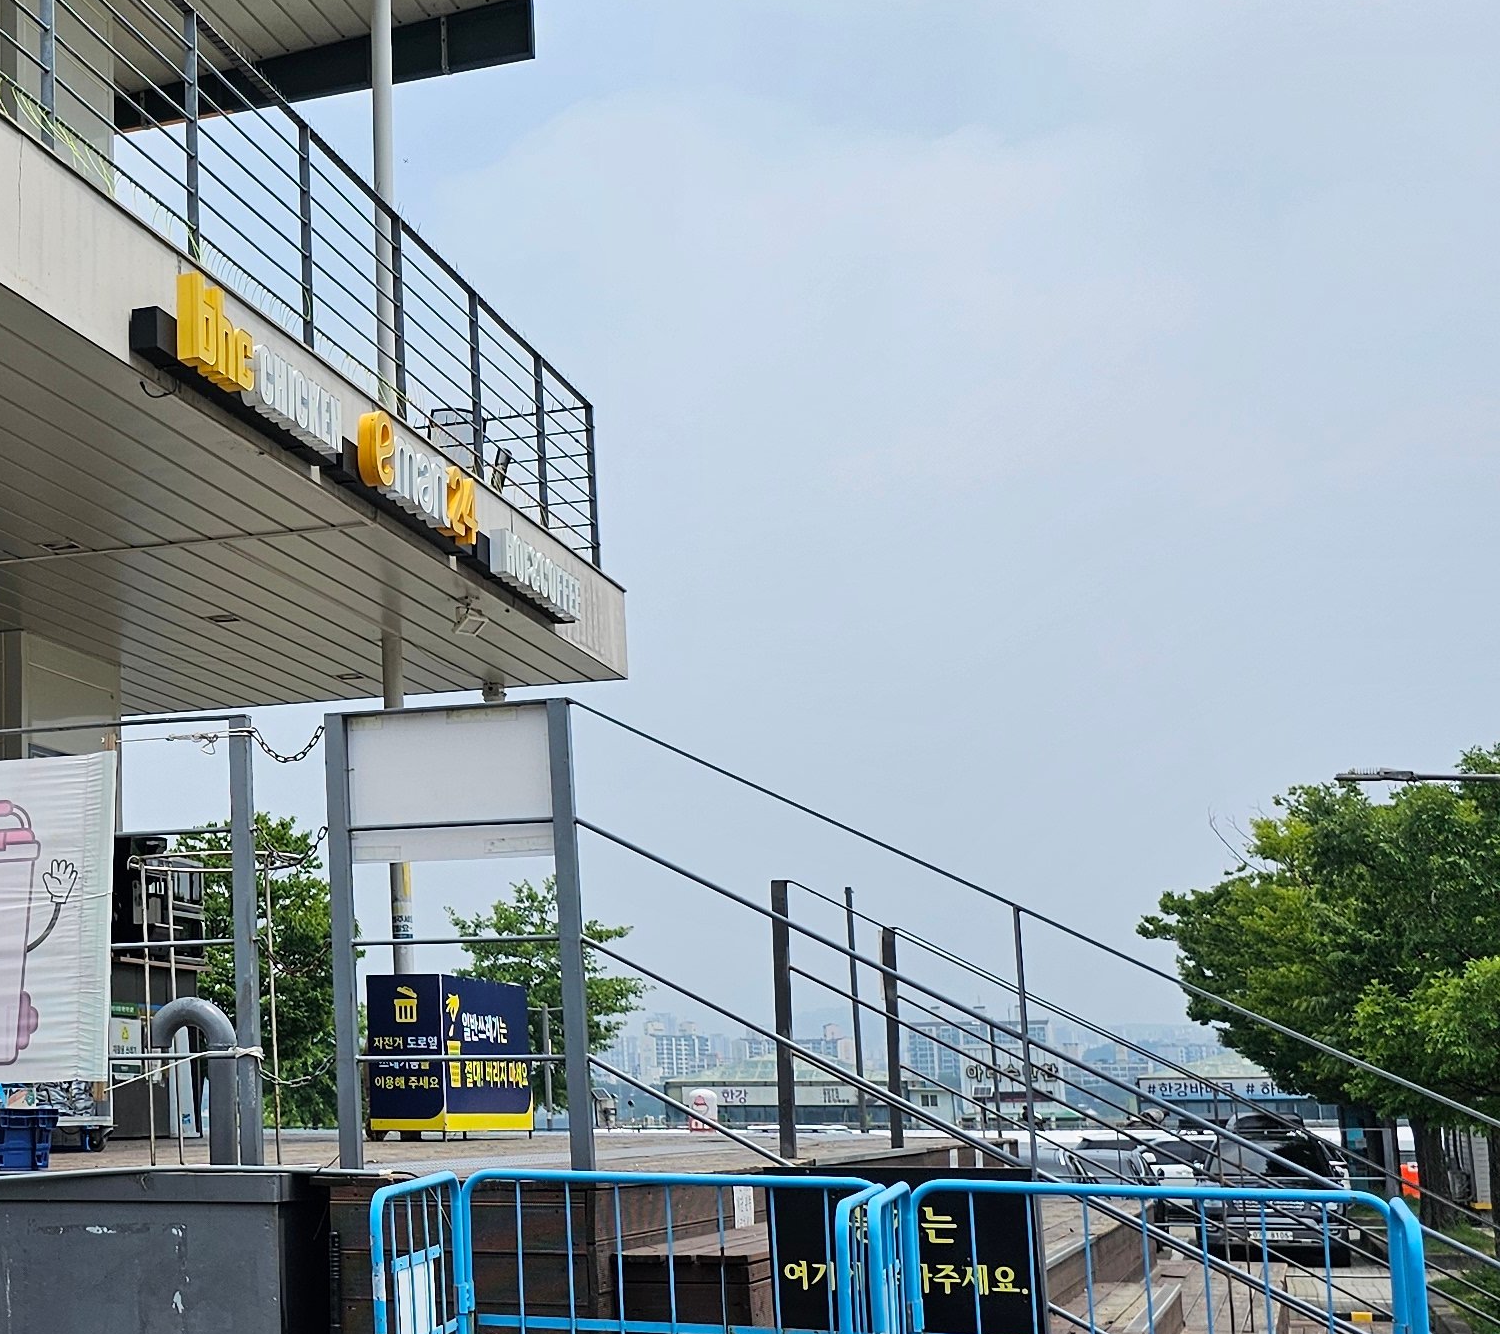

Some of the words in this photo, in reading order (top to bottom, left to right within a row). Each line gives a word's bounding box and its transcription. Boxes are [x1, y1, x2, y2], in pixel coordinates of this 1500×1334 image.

[177, 271, 254, 393] bhc
[252, 344, 343, 455] CHICKEN
[358, 410, 479, 545] emart24
[461, 1012, 508, 1044] 일반쓰레기는
[373, 1036, 403, 1050] 자전거
[406, 1036, 438, 1050] 도로옆
[374, 1076, 406, 1090] 이용해
[408, 1076, 440, 1090] 주세요
[485, 1061, 508, 1089] 버리지
[722, 1088, 749, 1104] 한강
